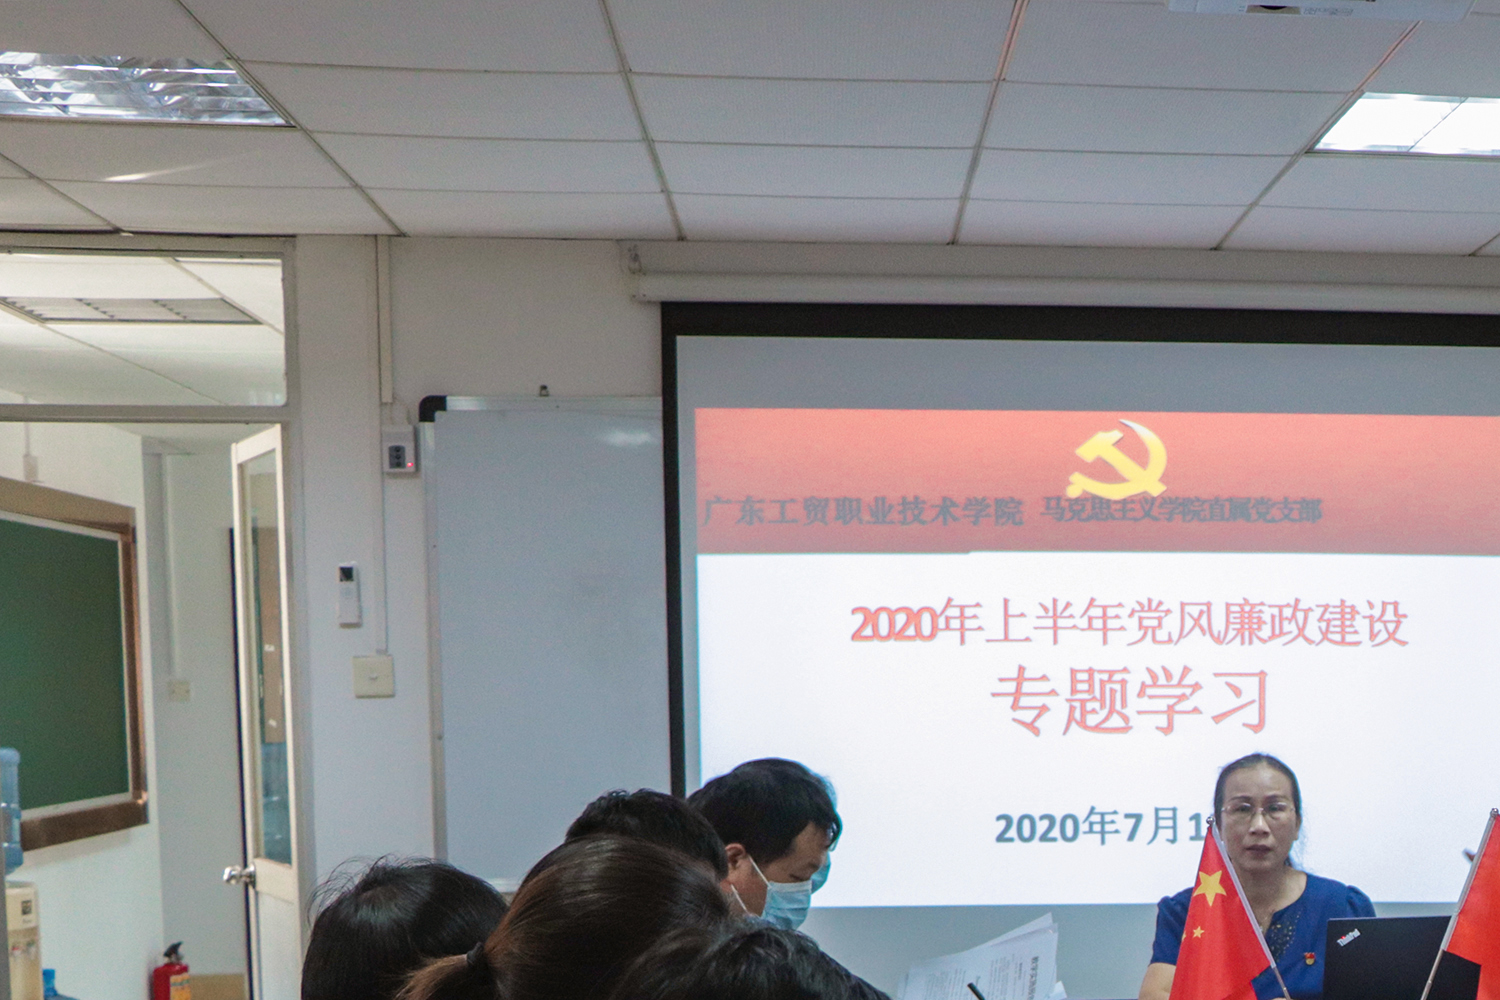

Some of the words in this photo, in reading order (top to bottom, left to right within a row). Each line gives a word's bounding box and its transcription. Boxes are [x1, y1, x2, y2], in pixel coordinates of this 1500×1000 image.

[702, 495, 1024, 527] 广东工贸职业技术学院
[1041, 495, 1323, 523] 马克思主义学院直属党支部
[851, 596, 1410, 647] 2020年上半年党风廉政建设
[990, 663, 1269, 737] 专题学习
